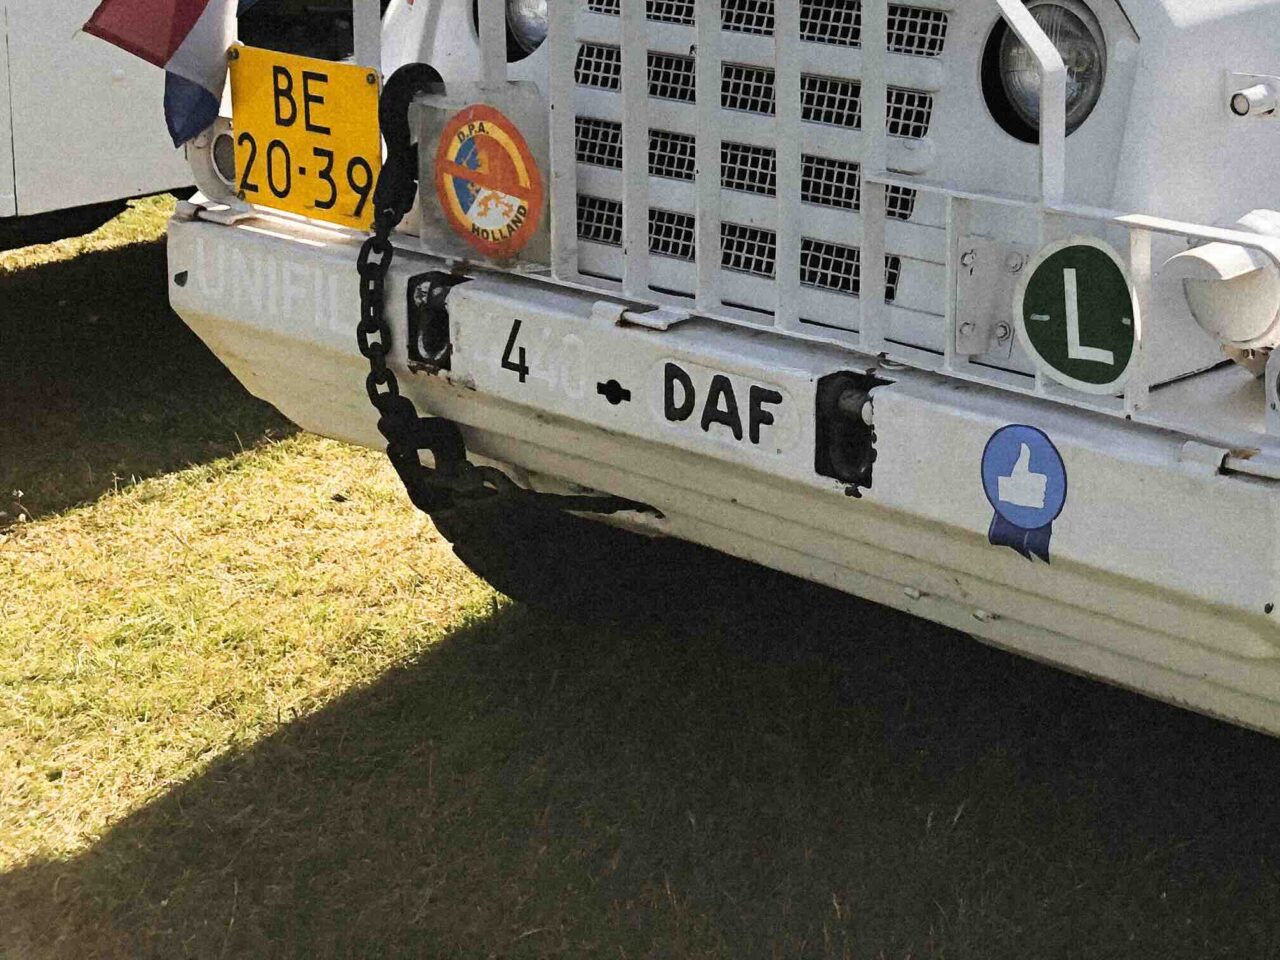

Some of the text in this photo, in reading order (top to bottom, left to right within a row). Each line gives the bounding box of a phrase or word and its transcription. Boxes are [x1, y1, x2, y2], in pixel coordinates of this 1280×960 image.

[272, 65, 331, 135] BE
[472, 204, 528, 241] HOLLAND
[1063, 268, 1115, 365] L
[664, 362, 783, 444] DAF
